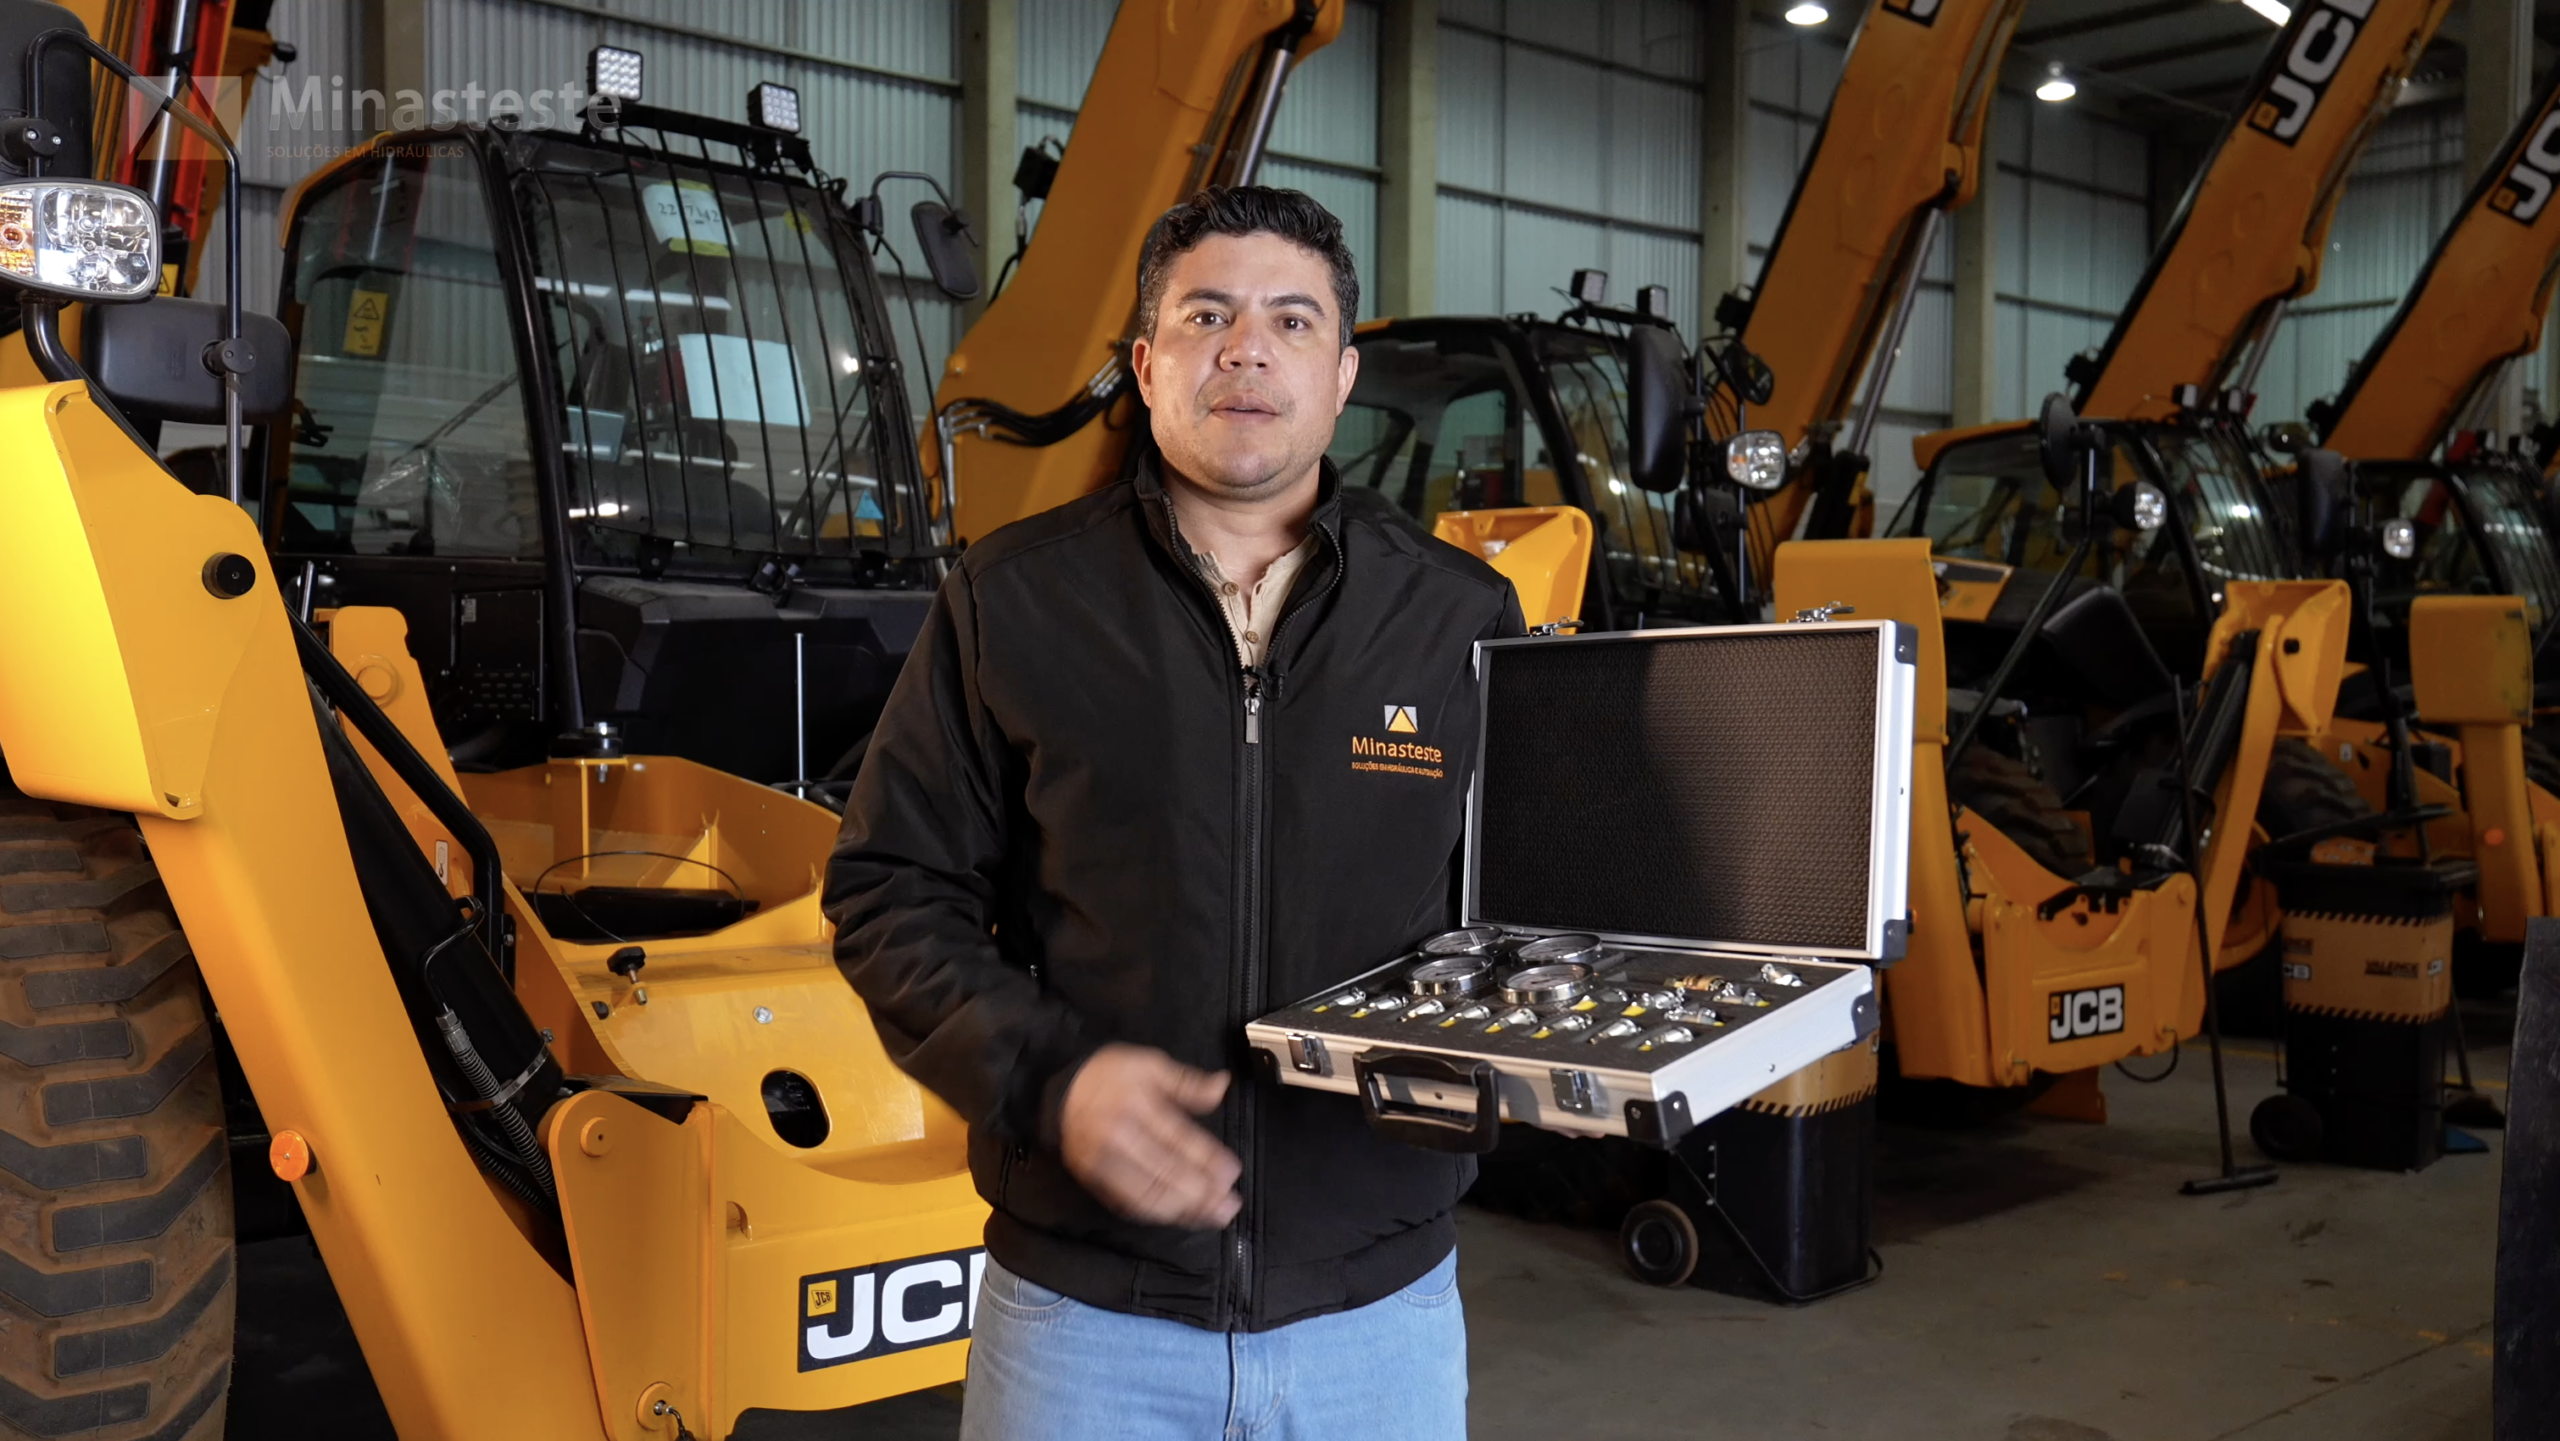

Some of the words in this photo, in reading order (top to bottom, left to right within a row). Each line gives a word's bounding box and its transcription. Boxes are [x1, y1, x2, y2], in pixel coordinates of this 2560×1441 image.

[2271, 0, 2375, 138] JC
[2511, 108, 2560, 219] JC
[1352, 736, 1442, 763] Minasteste
[2050, 987, 2123, 1039] JCB
[815, 1291, 831, 1306] JCB
